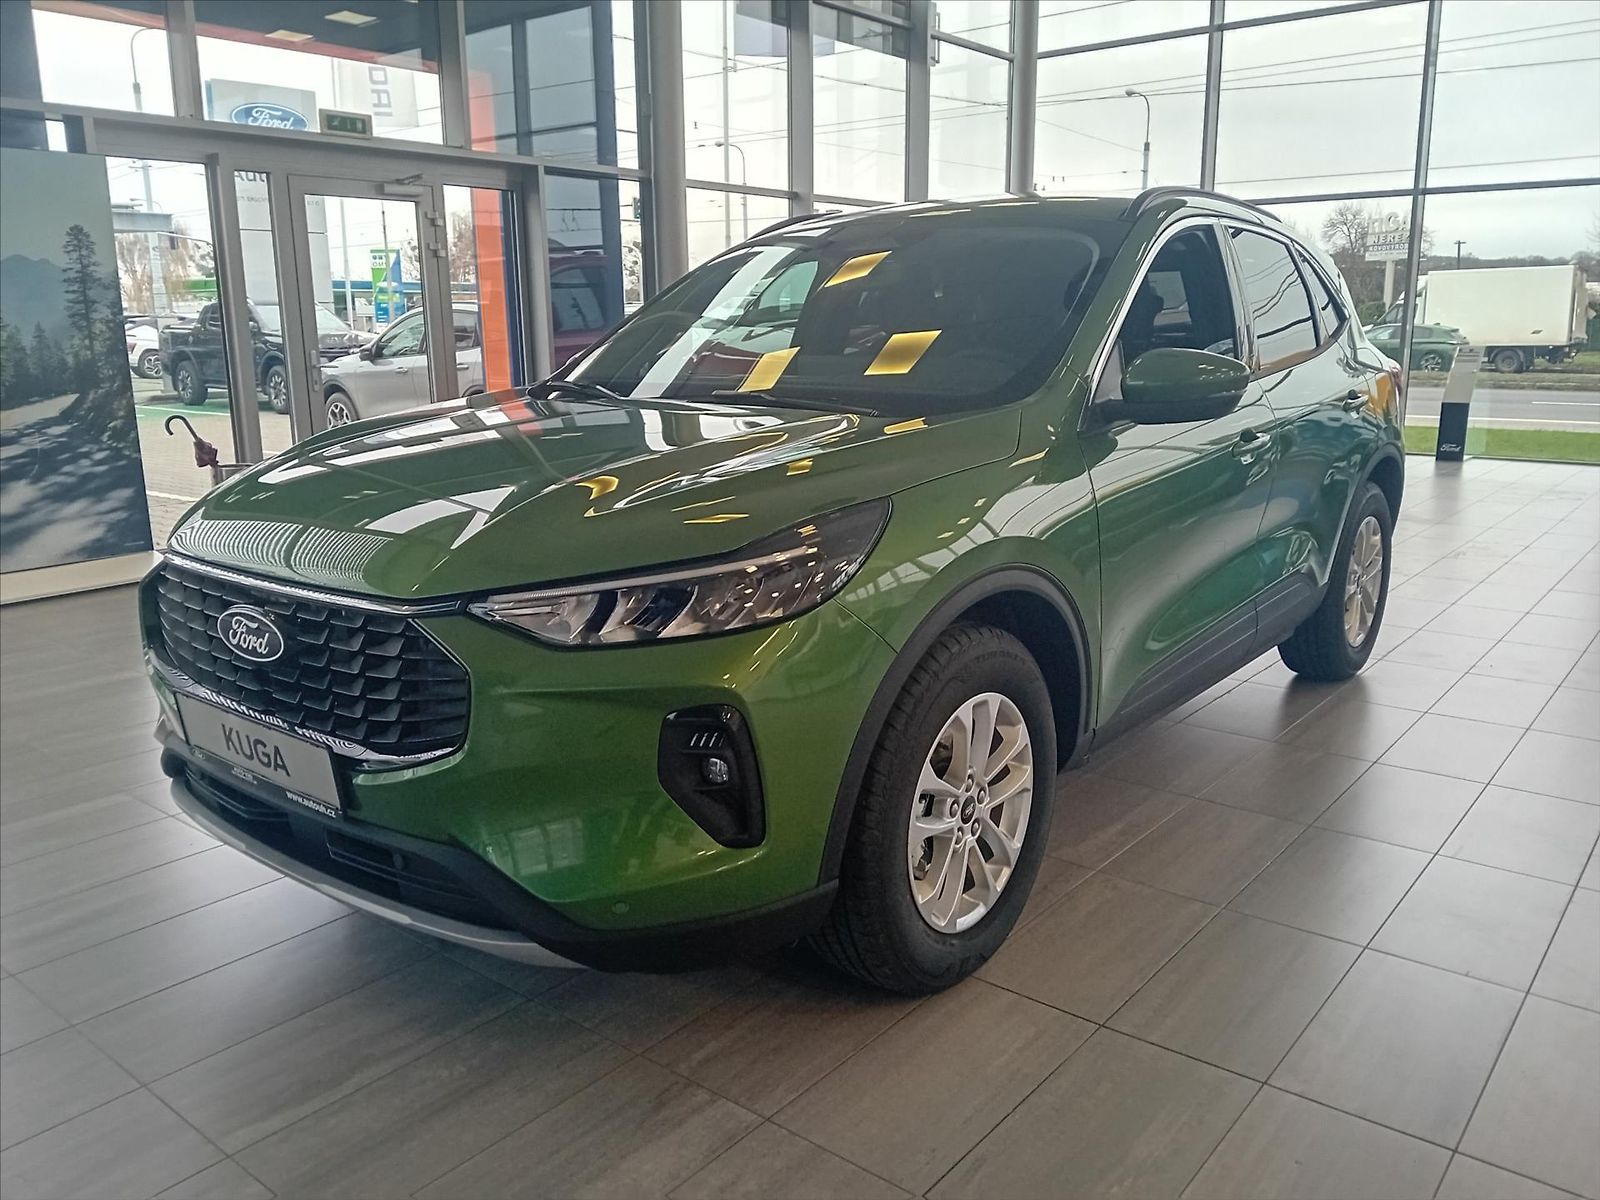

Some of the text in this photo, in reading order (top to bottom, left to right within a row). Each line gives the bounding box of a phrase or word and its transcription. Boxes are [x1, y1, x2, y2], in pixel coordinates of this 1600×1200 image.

[247, 107, 295, 130] Ford
[229, 616, 269, 655] Ford
[221, 723, 291, 778] KUGA
